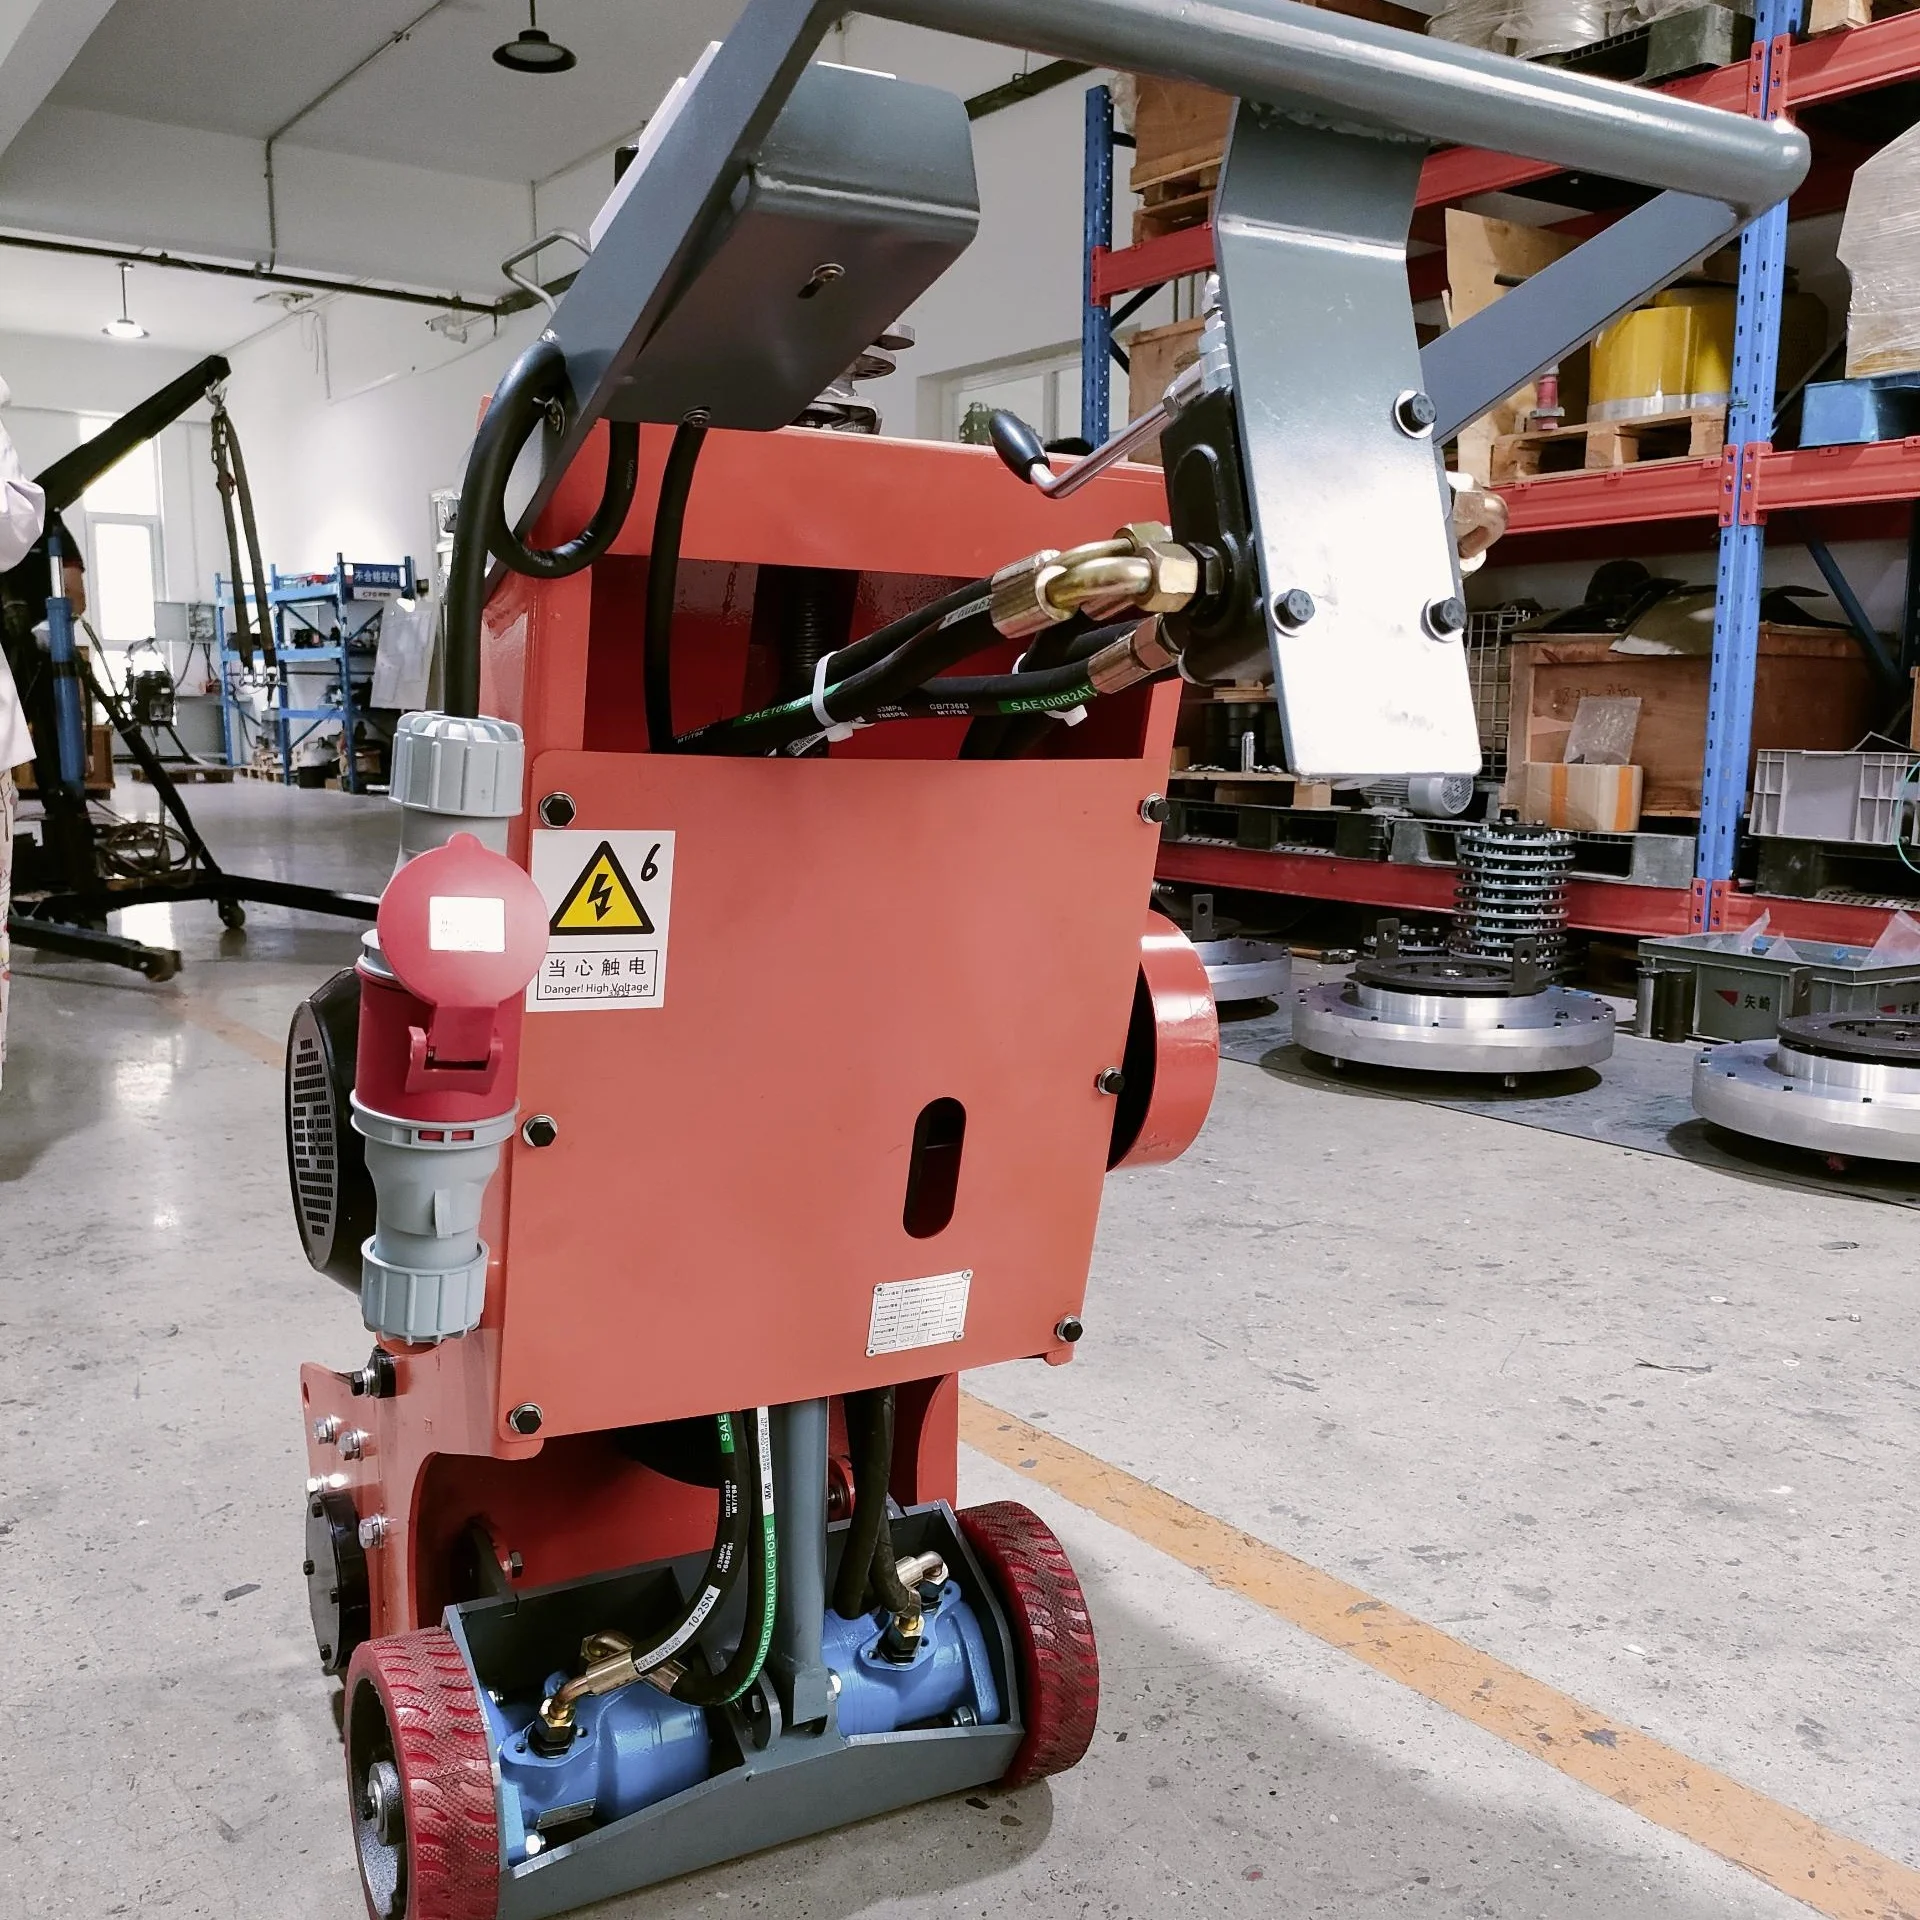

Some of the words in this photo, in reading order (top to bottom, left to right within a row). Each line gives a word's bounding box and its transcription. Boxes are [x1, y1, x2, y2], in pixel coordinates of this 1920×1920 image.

[743, 695, 812, 722] SAE100R2A
[929, 702, 970, 710] GB/T3683
[1010, 684, 1095, 711] SAE100R2AT
[641, 843, 661, 882] 6
[548, 956, 647, 978] 当心触电
[544, 984, 583, 996] Danger!
[586, 982, 609, 995] High
[611, 981, 649, 994] Voltage
[1744, 993, 1771, 1012] 矢崎
[718, 1413, 731, 1442] SAE
[766, 1525, 775, 1550] HOSE
[764, 1550, 777, 1629] HYDRAULIC
[688, 1592, 714, 1628] 10-2SN
[750, 1630, 771, 1679] BRAIDED
